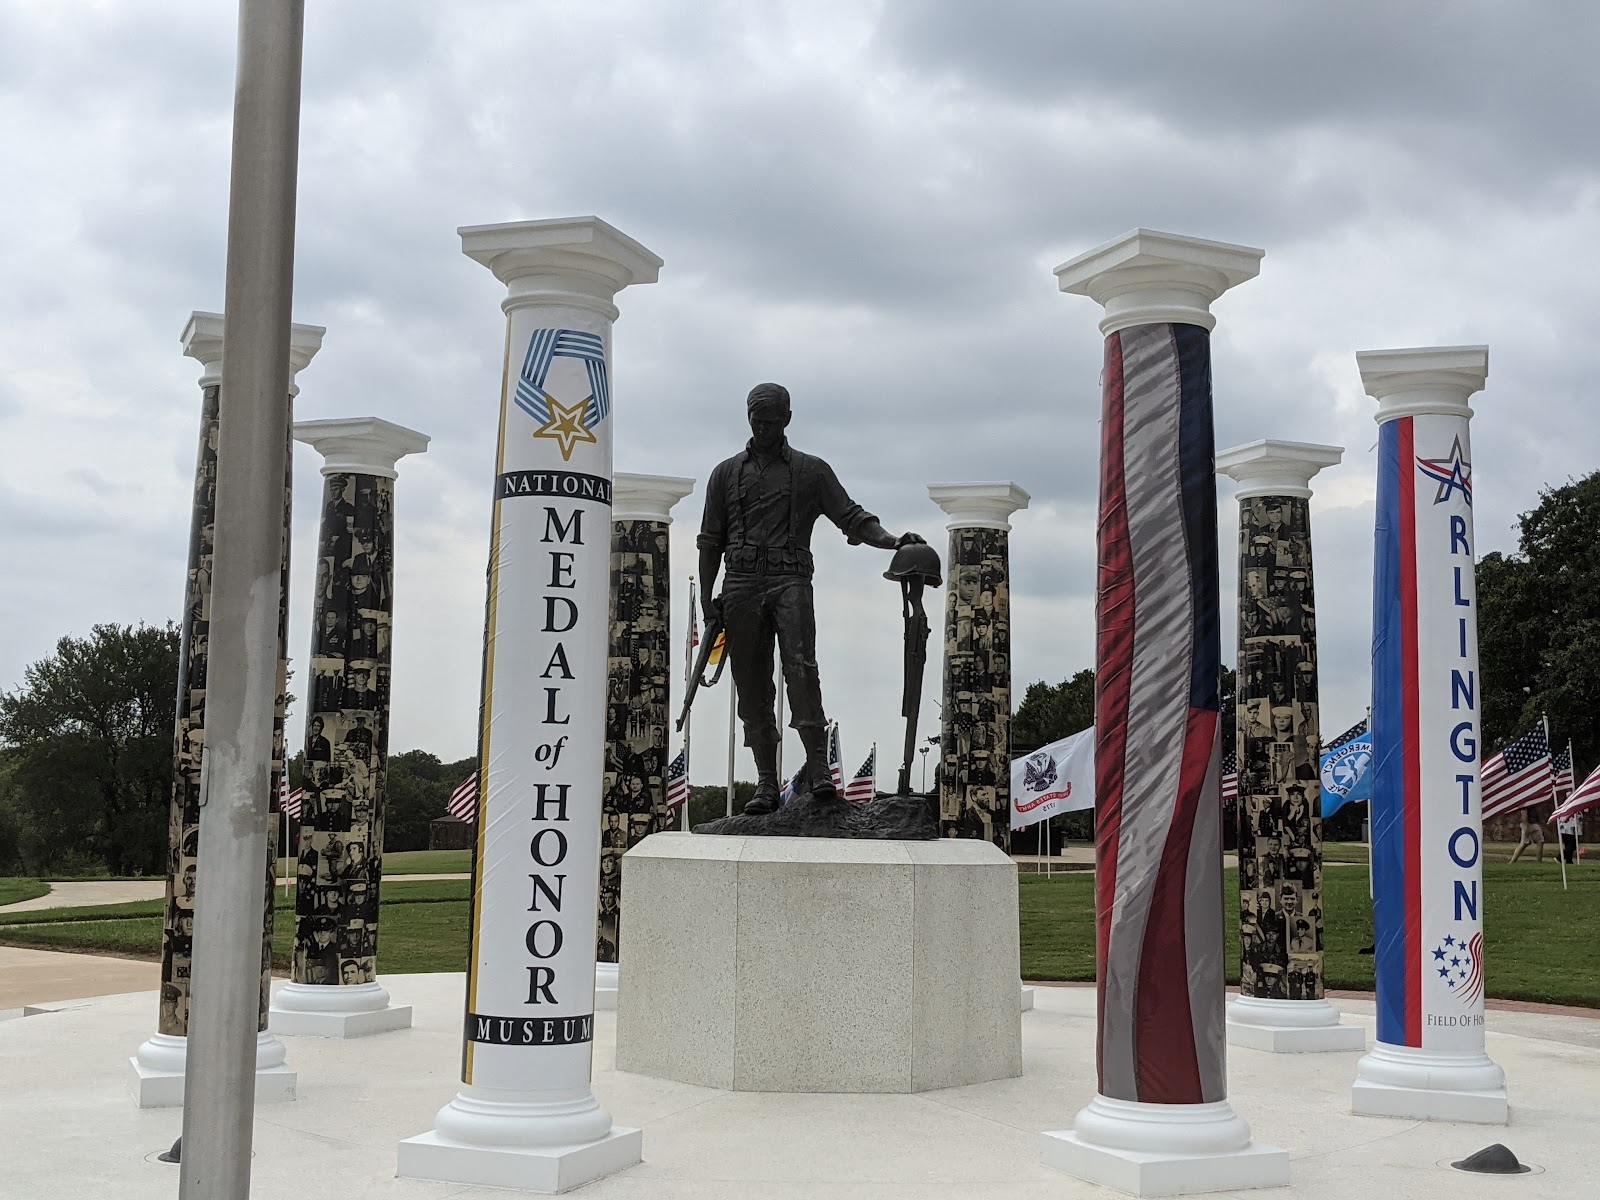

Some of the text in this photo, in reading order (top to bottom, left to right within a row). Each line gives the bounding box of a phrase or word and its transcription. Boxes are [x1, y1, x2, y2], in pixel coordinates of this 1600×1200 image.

[504, 474, 611, 502] NATIONAL
[523, 506, 585, 1005] MEDAL of HONOR
[476, 1017, 592, 1043] MUSEUM
[1427, 1013, 1457, 1027] FIELD
